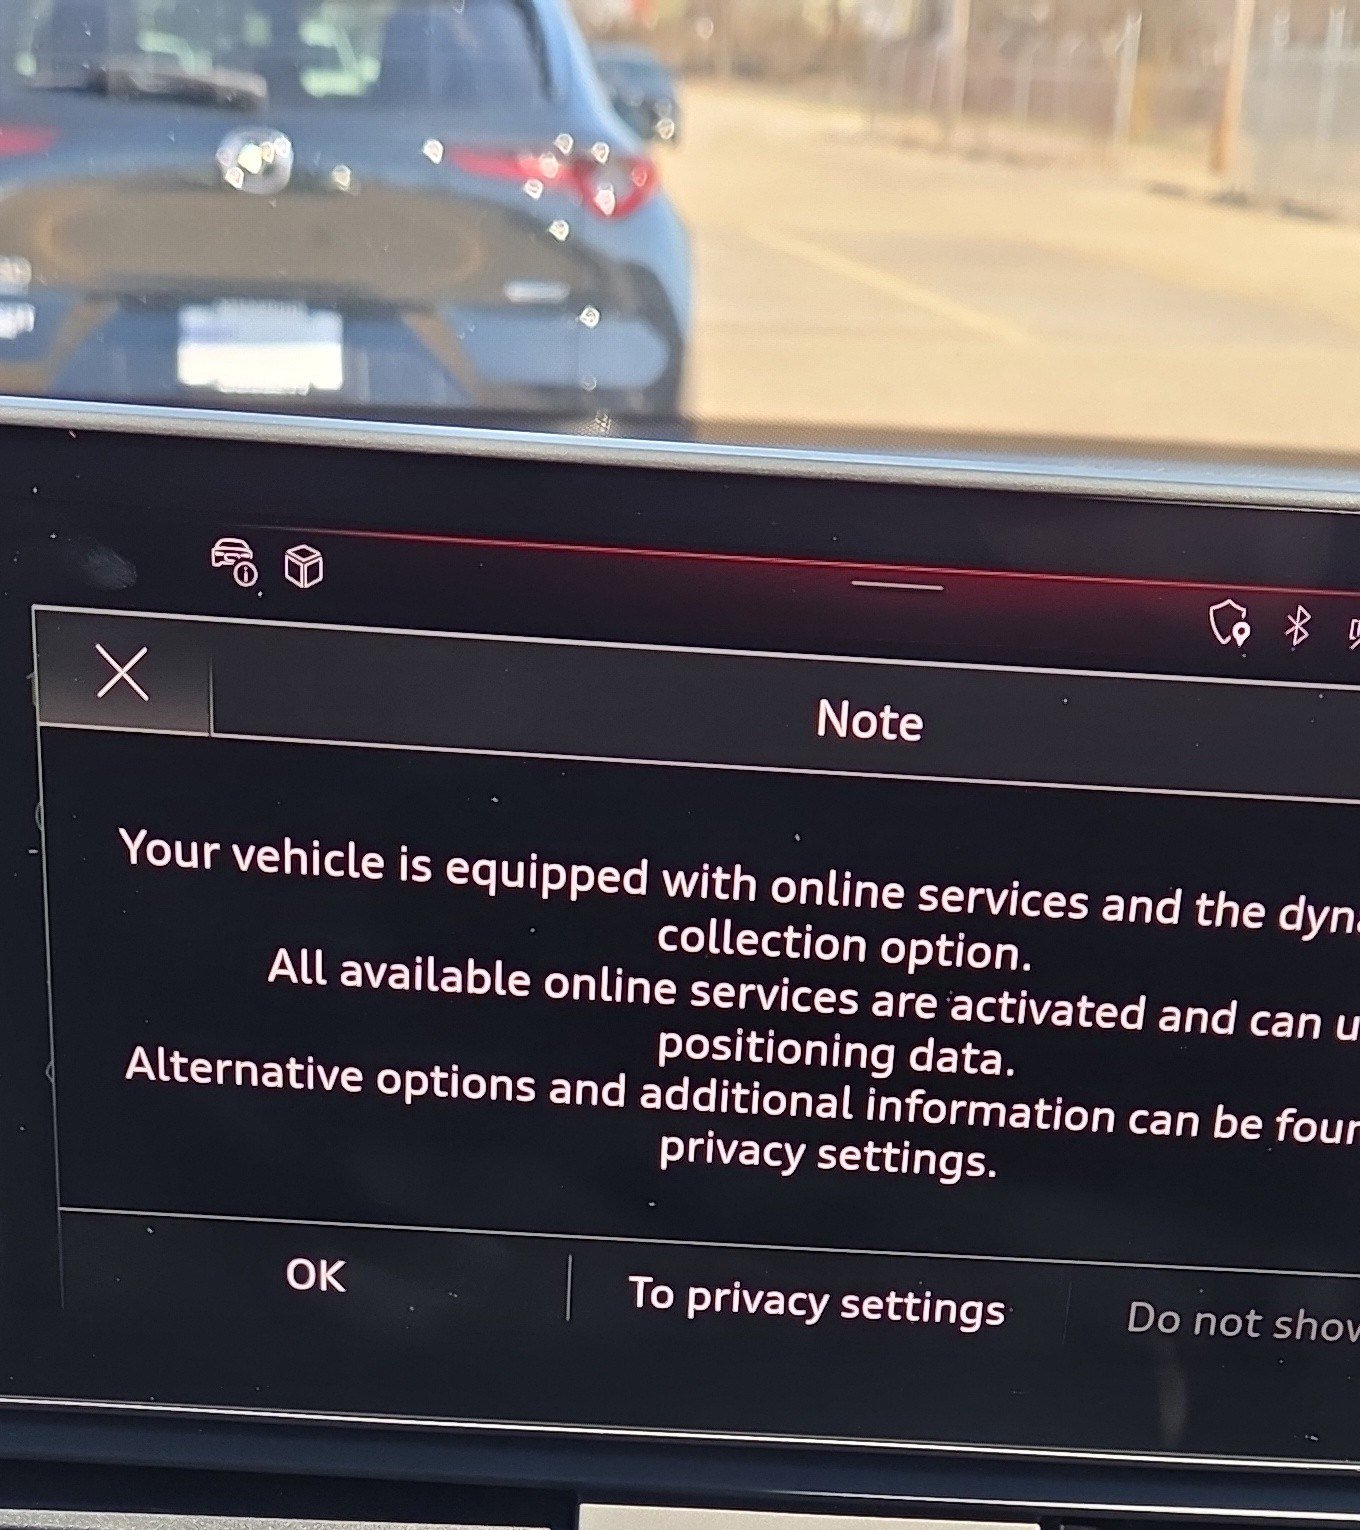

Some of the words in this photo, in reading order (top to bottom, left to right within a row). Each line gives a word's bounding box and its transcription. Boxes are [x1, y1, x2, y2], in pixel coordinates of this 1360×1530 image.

[817, 698, 924, 742] Note
[118, 827, 221, 870] Your
[231, 836, 385, 880] vehicle
[400, 844, 432, 883] is
[446, 852, 649, 902] equipped
[662, 862, 757, 902] with
[771, 868, 905, 910] online
[917, 880, 1089, 920] services
[1101, 887, 1183, 925] and
[1195, 890, 1266, 929] the
[658, 917, 867, 963] collection
[880, 932, 1031, 975] option.
[267, 947, 328, 986] All
[340, 955, 531, 997] available
[544, 965, 677, 1005] online
[690, 976, 859, 1015] services
[871, 990, 938, 1020] are
[950, 989, 1147, 1031] activated
[1158, 999, 1238, 1035] and
[1250, 1010, 1322, 1040] can
[658, 1027, 896, 1079] positioning
[909, 1036, 1014, 1077] data.
[125, 1045, 364, 1093] Alternative
[376, 1063, 536, 1105] options
[549, 1072, 626, 1108] and
[640, 1075, 854, 1120] additional
[866, 1086, 1115, 1133] information
[1128, 1109, 1200, 1137] can
[1213, 1103, 1263, 1140] be
[660, 1129, 807, 1177] privacy
[817, 1139, 996, 1185] settings.
[286, 1257, 347, 1293] OK
[628, 1275, 674, 1309] To
[687, 1280, 831, 1326] privacy
[840, 1290, 1006, 1333] settings
[1127, 1301, 1181, 1334] Do
[1193, 1308, 1264, 1338] not
